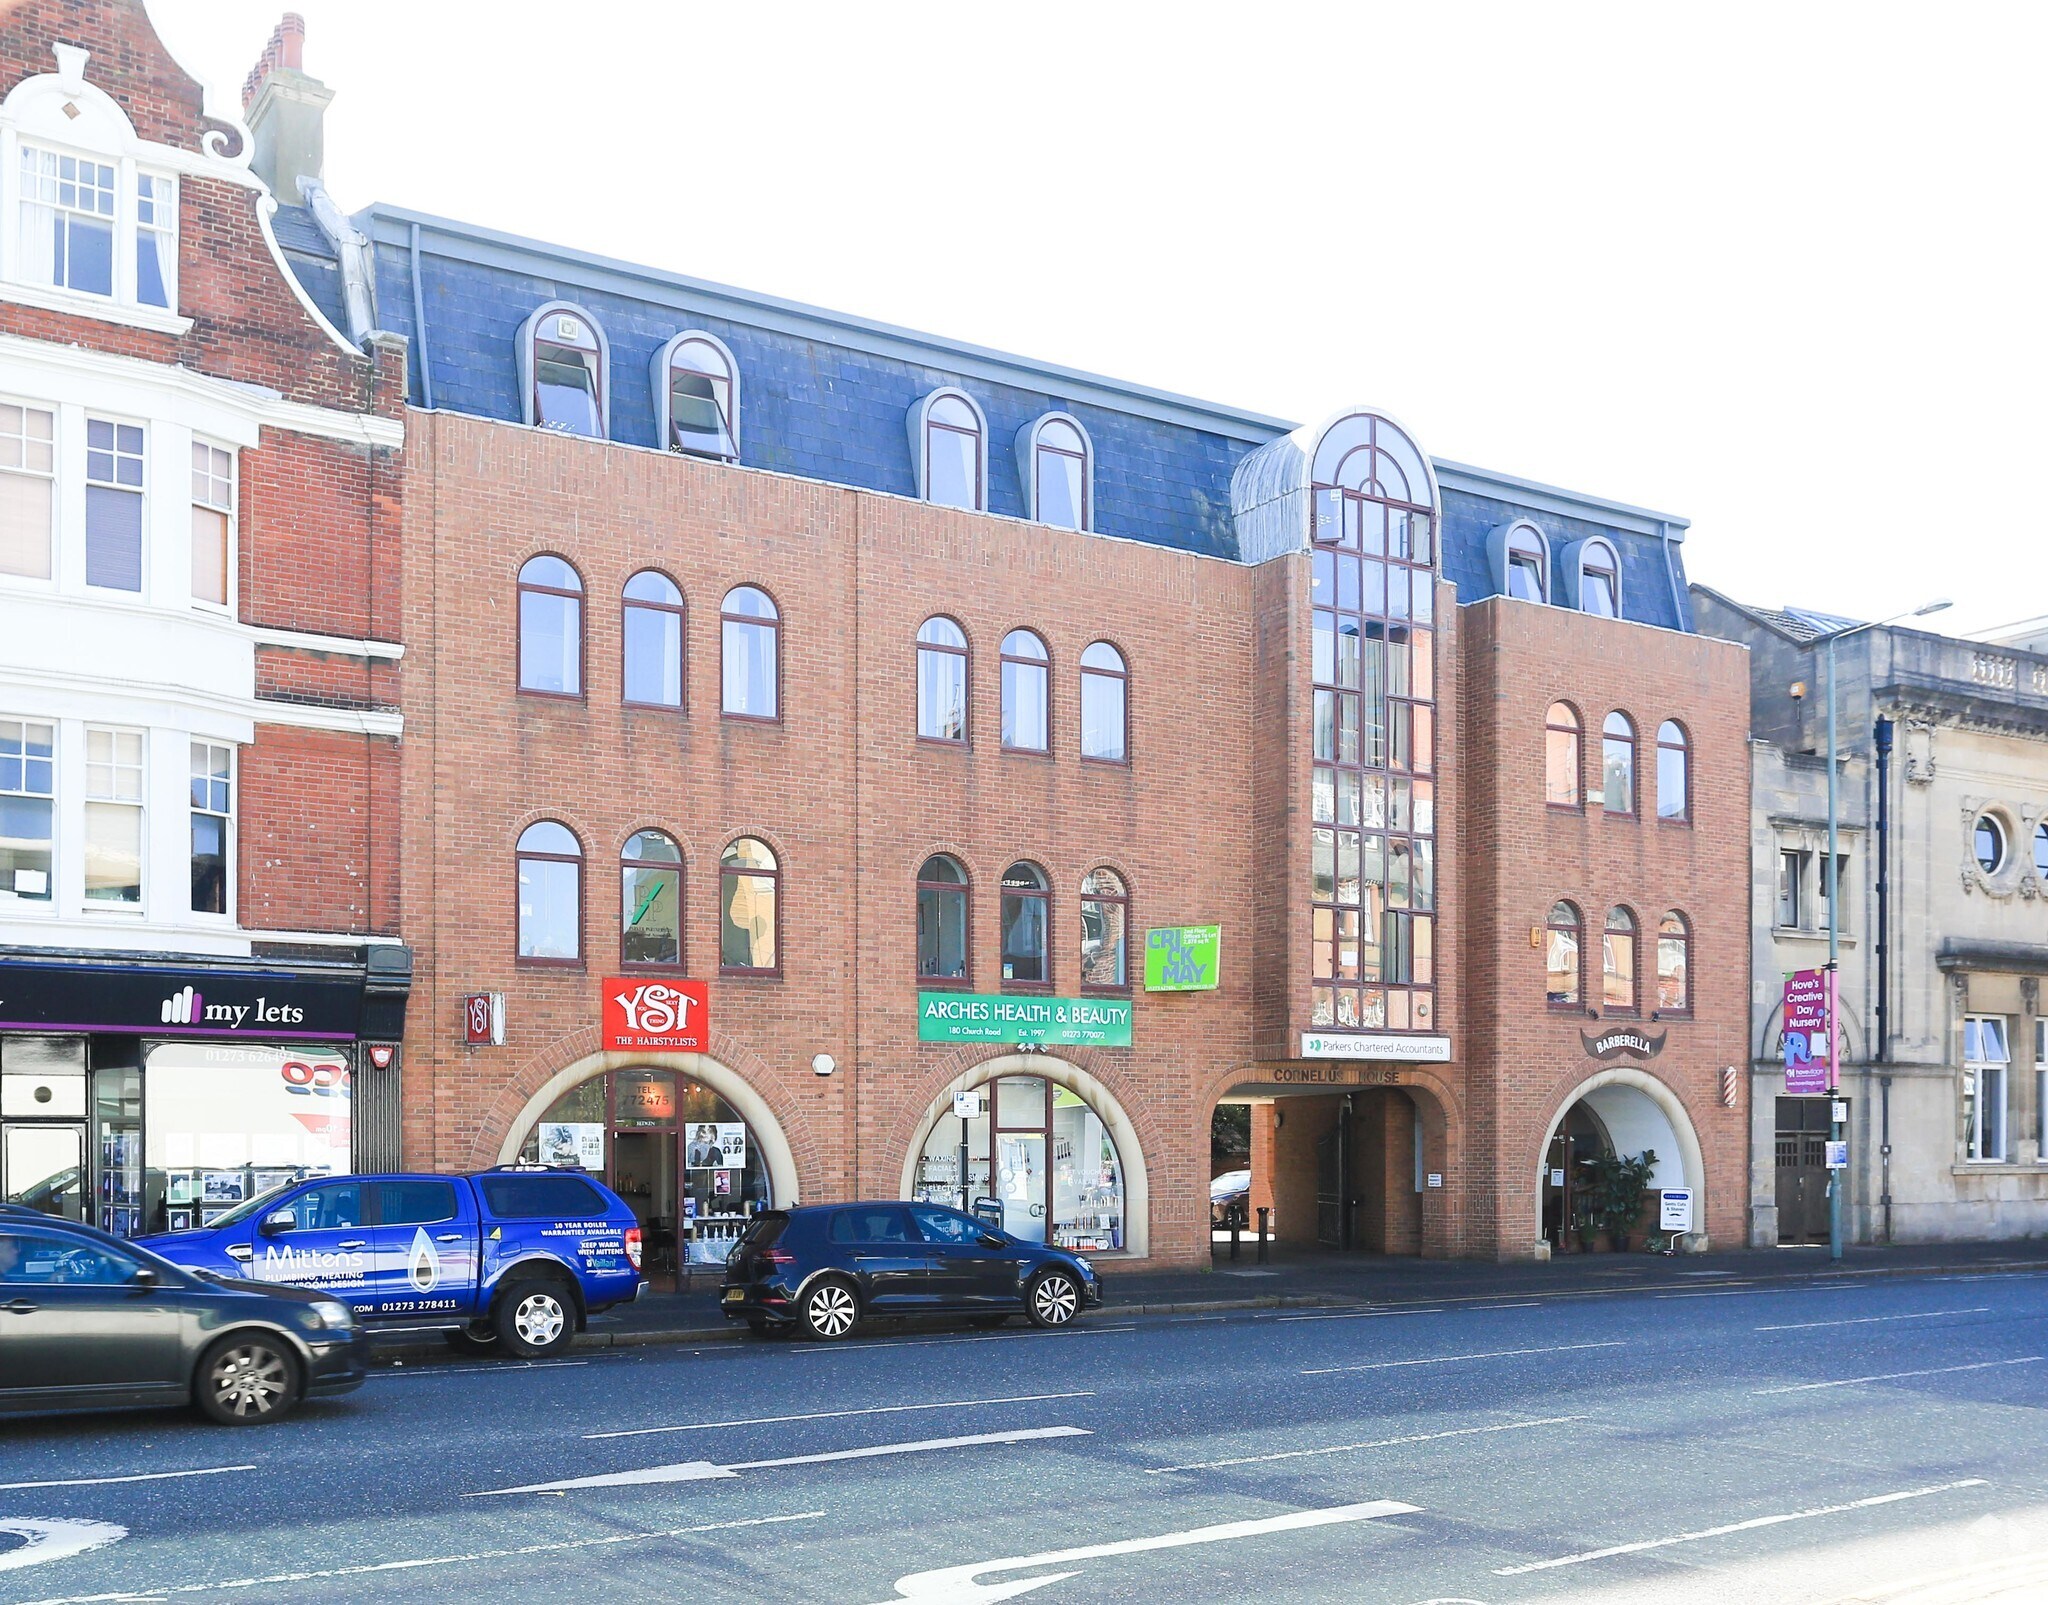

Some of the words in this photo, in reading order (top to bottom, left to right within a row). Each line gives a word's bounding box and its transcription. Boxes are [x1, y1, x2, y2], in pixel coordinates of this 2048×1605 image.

[1148, 929, 1181, 951] CRI
[1167, 946, 1195, 966] CK
[1162, 964, 1207, 985] MAY
[1791, 979, 1819, 990] Hove's
[1787, 991, 1823, 1003] Creative
[204, 1003, 250, 1029] my
[254, 997, 304, 1023] lets
[469, 998, 490, 1033] YST
[614, 985, 698, 1033] YST
[925, 1001, 989, 1020] ARCHES
[994, 1004, 1050, 1022] HEALTH
[1055, 1008, 1067, 1023] &
[1071, 1007, 1128, 1025] BEAUTY
[1796, 1006, 1814, 1016] Day
[1789, 1018, 1821, 1028] Nursery
[949, 1026, 960, 1035] 180
[961, 1027, 984, 1036] Church
[985, 1027, 1001, 1036] Road
[1018, 1029, 1028, 1037] Est.
[1030, 1029, 1045, 1037] 1997
[1062, 1030, 1081, 1038] 01273
[1081, 1031, 1105, 1039] 770072
[615, 1036, 632, 1045] THE
[637, 1036, 698, 1046] HAIRSTYLISTS
[1595, 1034, 1650, 1054] BARBERELLA
[1323, 1041, 1351, 1051] Parkers
[1354, 1041, 1393, 1052] Chartered
[1396, 1043, 1443, 1055] Accountants
[206, 1050, 244, 1061] 01273
[1274, 1069, 1343, 1082] CORNELIUS
[1359, 1071, 1400, 1083] HOUSE
[636, 1086, 656, 1094] TEL:
[622, 1095, 669, 1105] 772475
[265, 1244, 363, 1271] Mittens
[593, 1258, 616, 1267] Vaillant
[265, 1272, 318, 1282] PLUMBING,
[322, 1271, 363, 1280] HEATING
[330, 1279, 365, 1288] DESIGN
[381, 1301, 414, 1312] 01273
[418, 1299, 456, 1310] 278411
